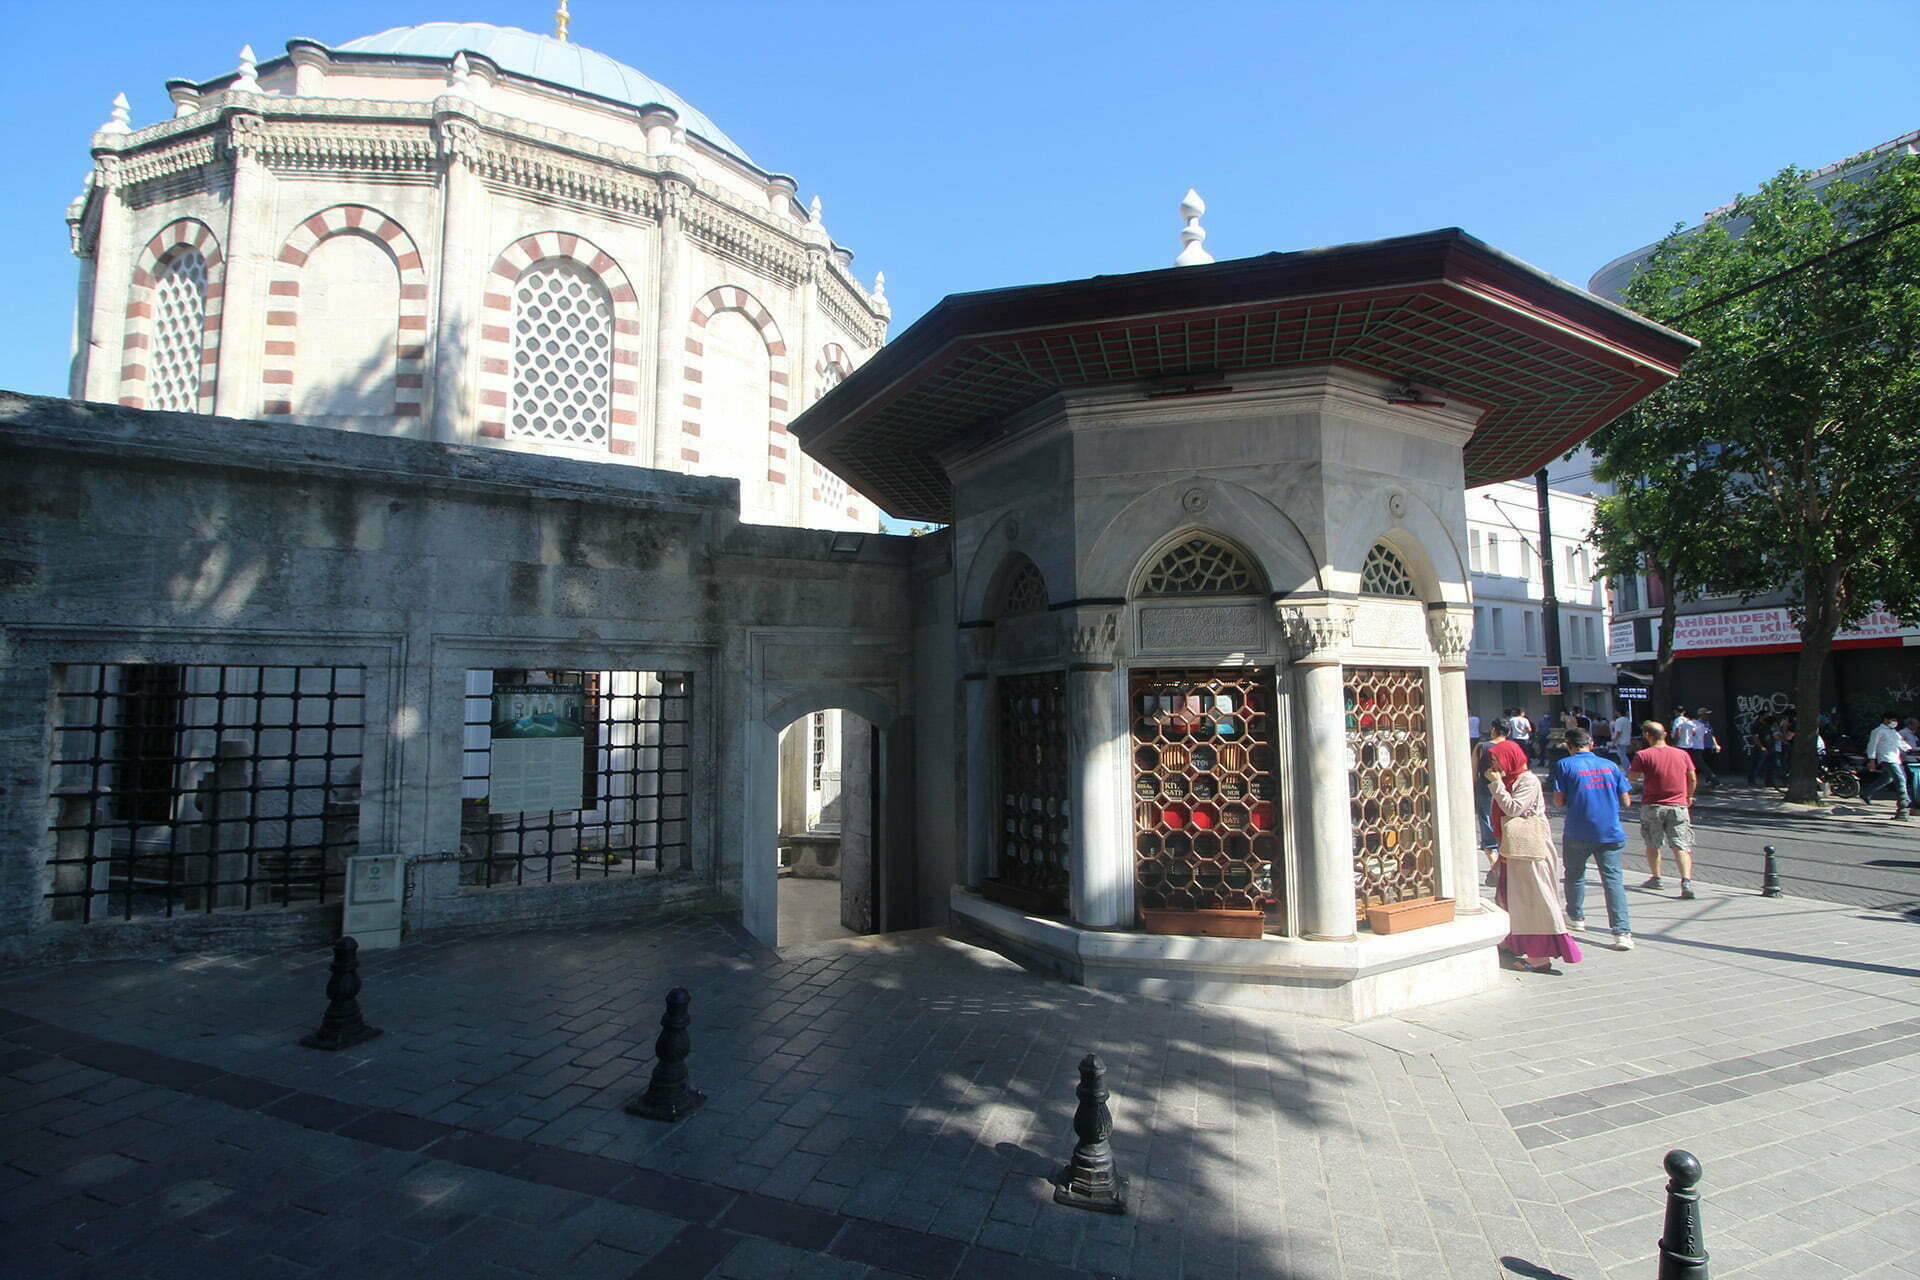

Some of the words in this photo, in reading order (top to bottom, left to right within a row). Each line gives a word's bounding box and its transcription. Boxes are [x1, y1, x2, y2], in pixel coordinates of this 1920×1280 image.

[1675, 611, 1780, 627] AHİBİNDEN
[1675, 624, 1753, 639] KOMPLE
[1760, 621, 1796, 633] KİR
